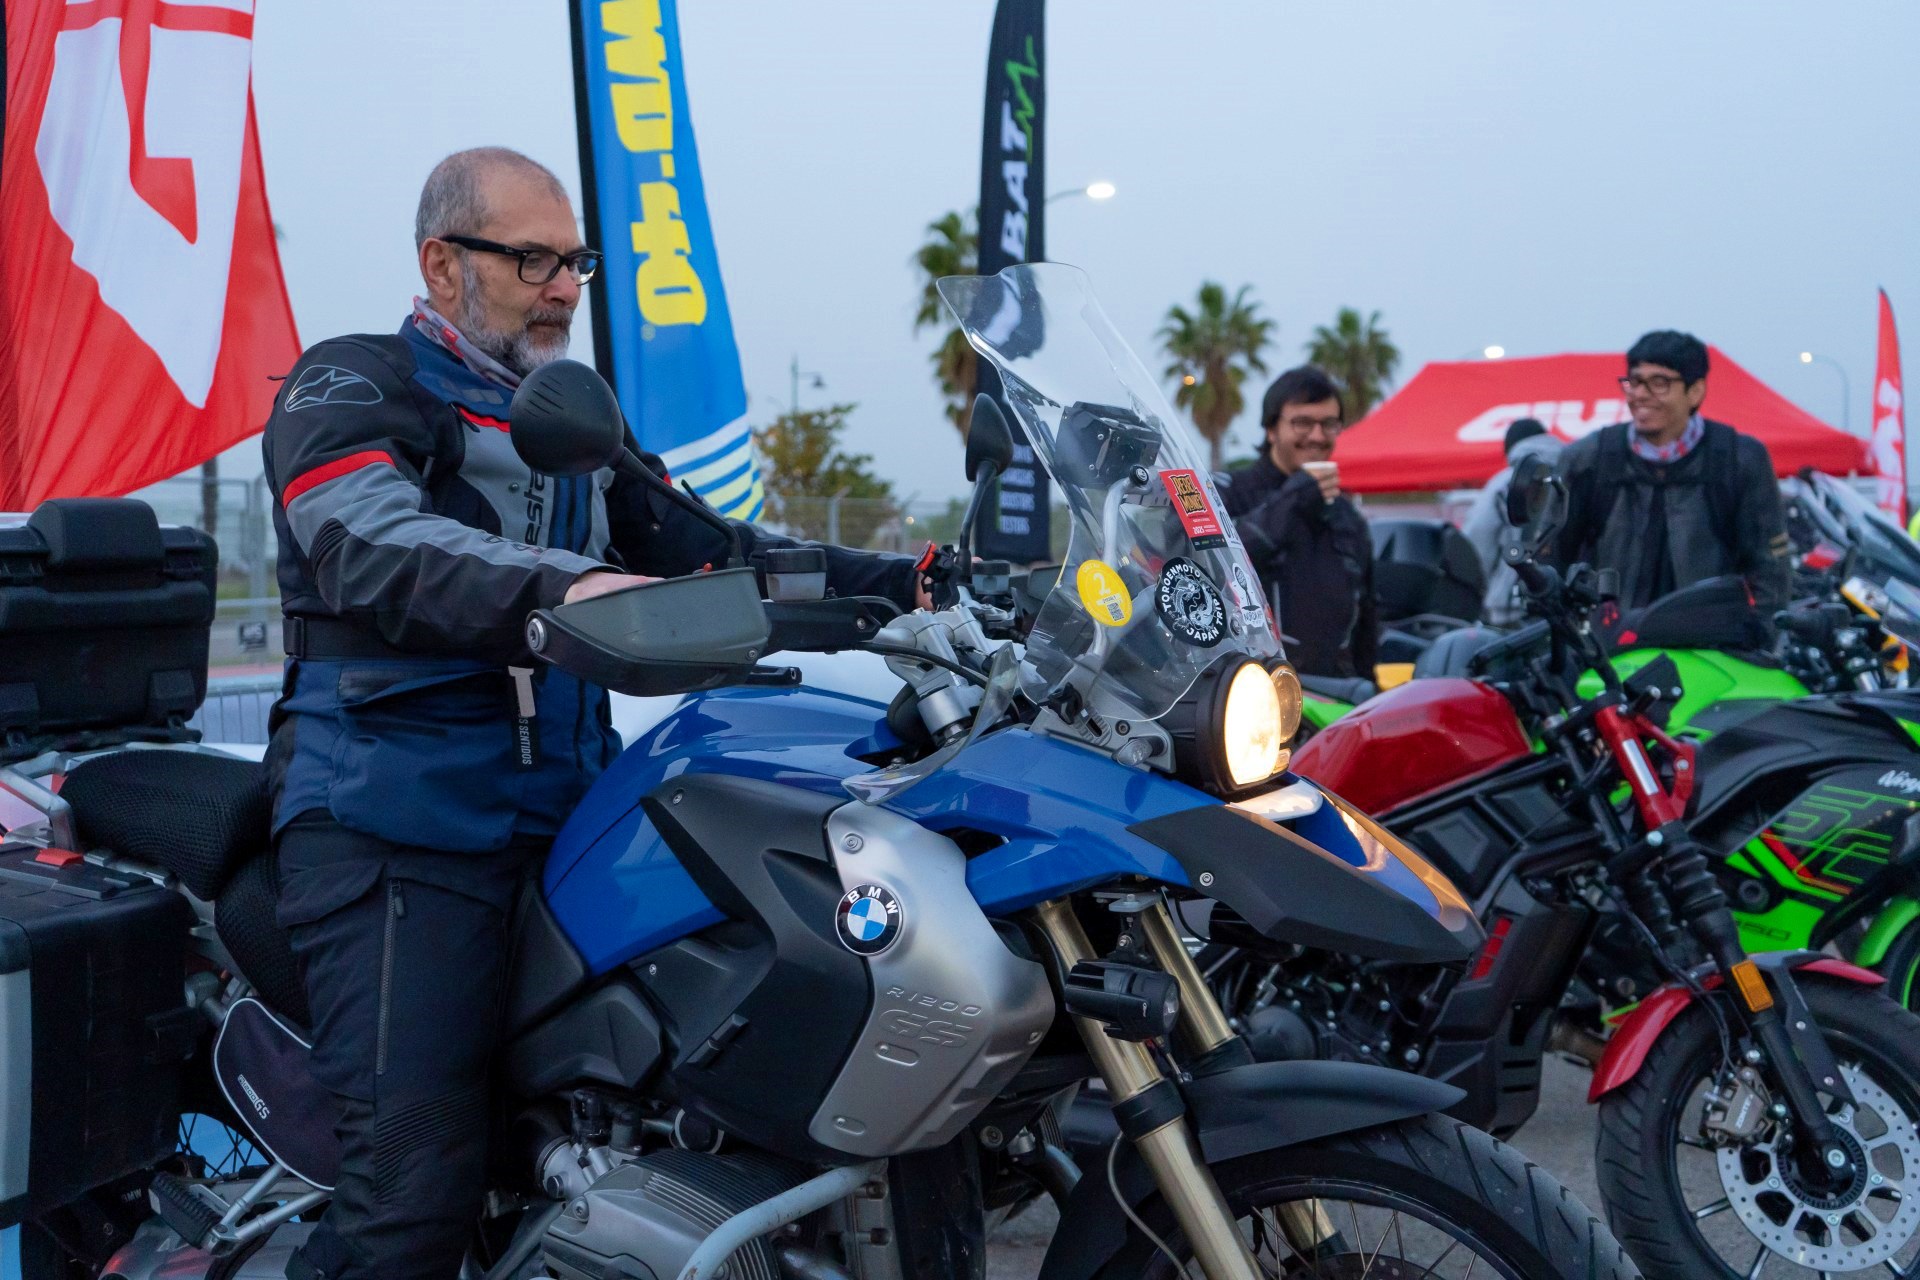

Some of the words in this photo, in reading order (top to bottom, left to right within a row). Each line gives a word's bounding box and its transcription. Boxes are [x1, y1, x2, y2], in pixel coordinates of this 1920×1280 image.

[600, 0, 707, 326] WD-40
[1093, 572, 1111, 596] 2
[1161, 563, 1201, 613] TOROENMOTO
[1186, 626, 1220, 642] JAPAN
[1213, 598, 1224, 626] TRIP
[519, 725, 533, 765] SENTIDOS
[847, 882, 898, 915] BMW
[879, 1008, 974, 1048] GS
